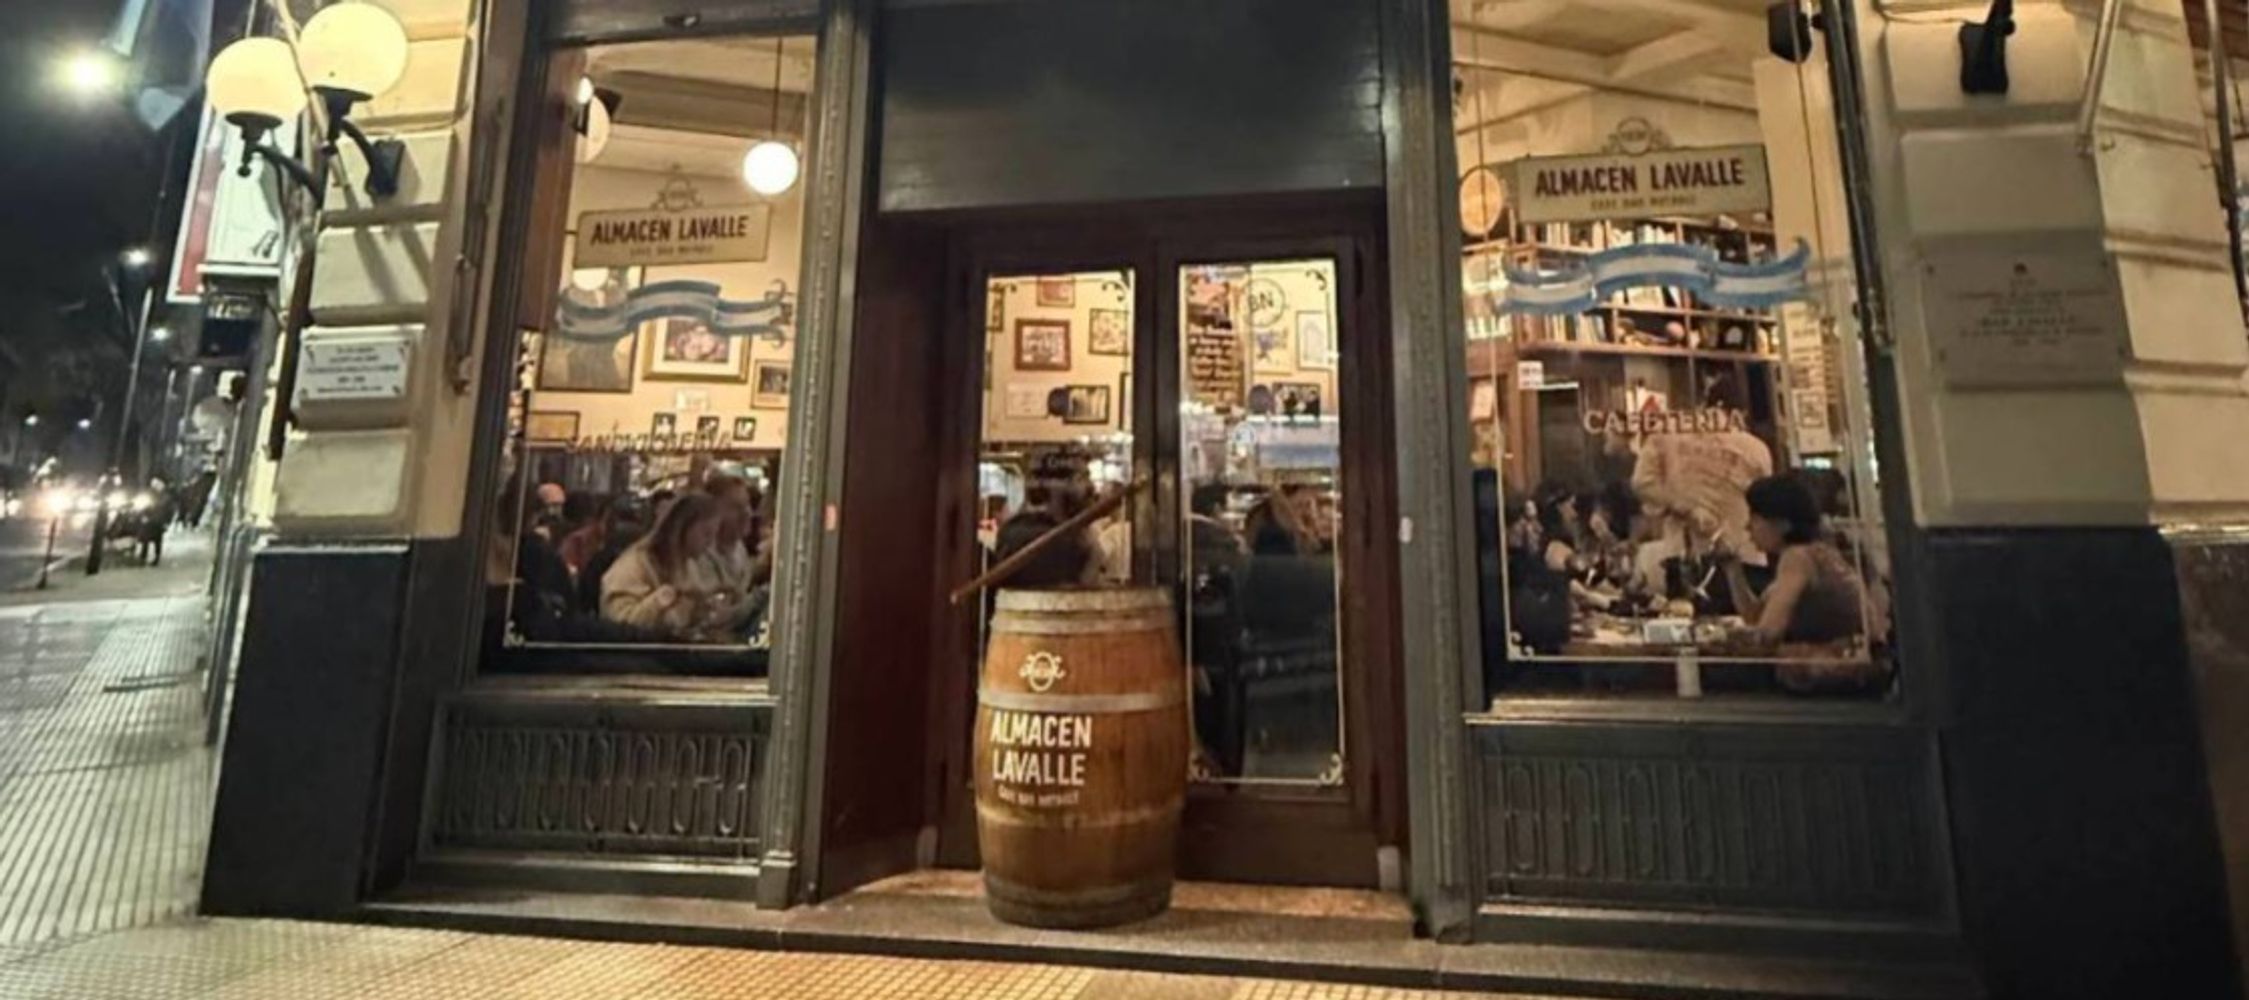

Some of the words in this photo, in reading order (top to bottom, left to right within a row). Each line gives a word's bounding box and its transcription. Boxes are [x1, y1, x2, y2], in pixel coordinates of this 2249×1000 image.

[1650, 158, 1745, 190] LAVALLE
[590, 218, 671, 246] ALMACEN
[678, 215, 749, 241] LAVALLE
[990, 710, 1092, 748] ALMACEN
[993, 749, 1086, 786] LAVALLE
